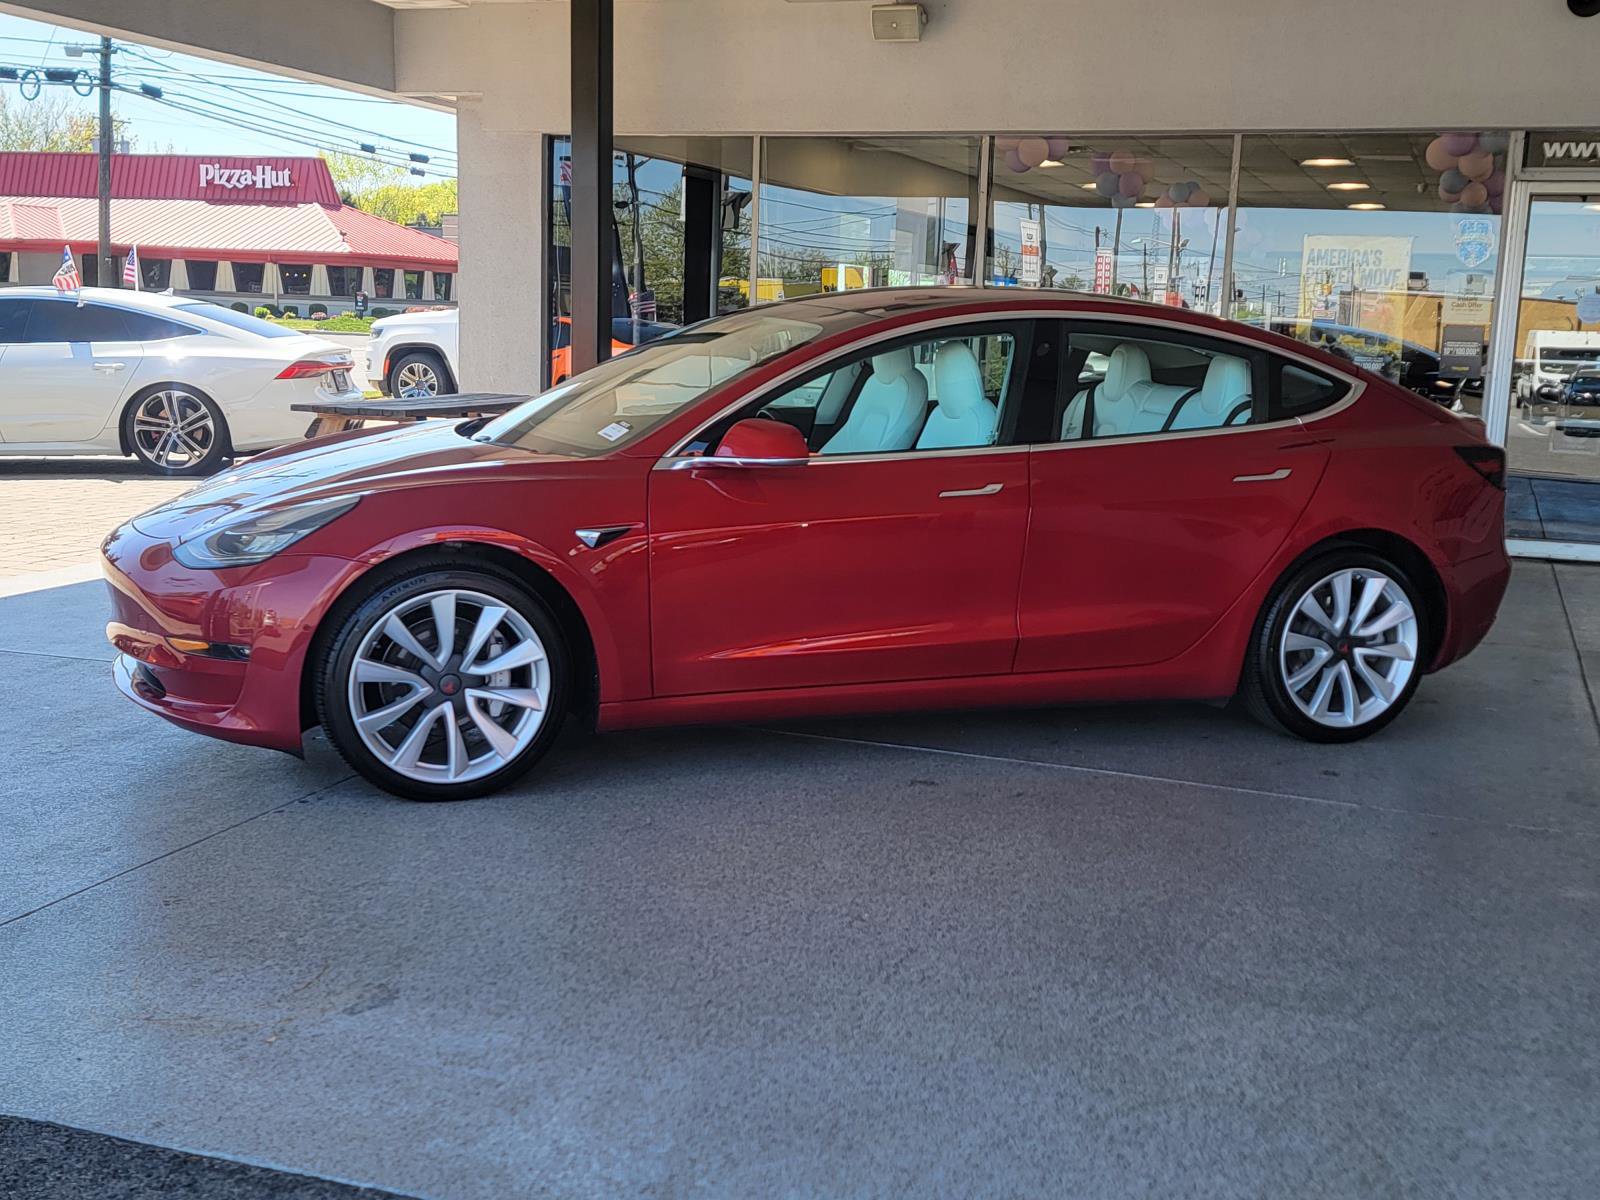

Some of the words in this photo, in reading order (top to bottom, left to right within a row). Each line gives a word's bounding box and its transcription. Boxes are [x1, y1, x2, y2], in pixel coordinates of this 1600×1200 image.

[1543, 142, 1600, 158] ww
[199, 163, 253, 189] Pizza
[255, 164, 292, 189] Hut
[1306, 248, 1383, 266] AMERICA'S
[1359, 268, 1402, 288] MOVE
